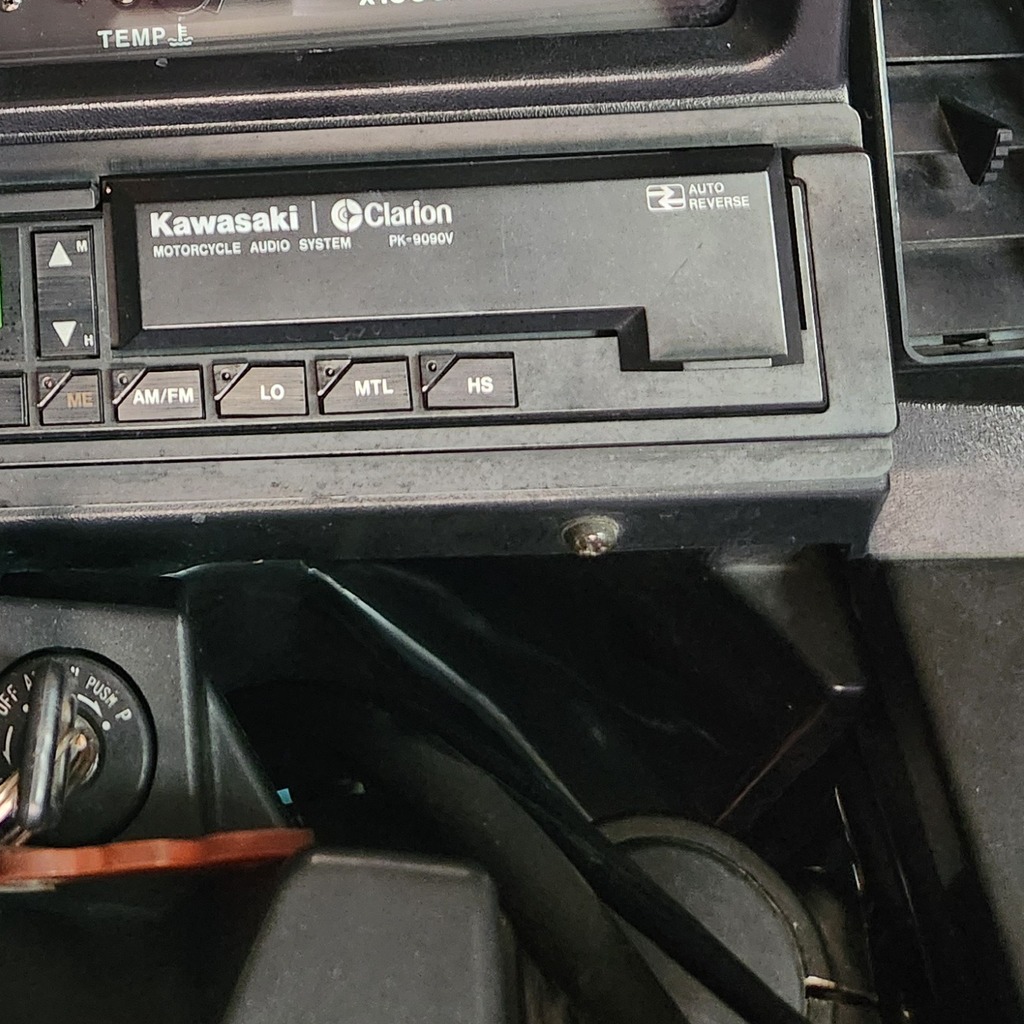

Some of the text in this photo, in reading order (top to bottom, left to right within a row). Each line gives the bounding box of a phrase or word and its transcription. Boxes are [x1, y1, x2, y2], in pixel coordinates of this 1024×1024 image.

[97, 27, 167, 49] TEMP
[689, 182, 725, 195] AUTO
[689, 196, 750, 210] REVERSE
[150, 200, 453, 238] Kawasaki Clarion
[76, 239, 88, 253] M
[152, 236, 352, 259] MOTORCYCLE AUDIO SYSTEM
[389, 231, 454, 247] PK-9090V
[84, 334, 94, 347] H
[259, 384, 285, 401] LO
[354, 379, 394, 398] MTL
[467, 376, 494, 394] HS
[66, 392, 94, 409] ME
[132, 387, 195, 406] AM/FM
[115, 708, 132, 721] P
